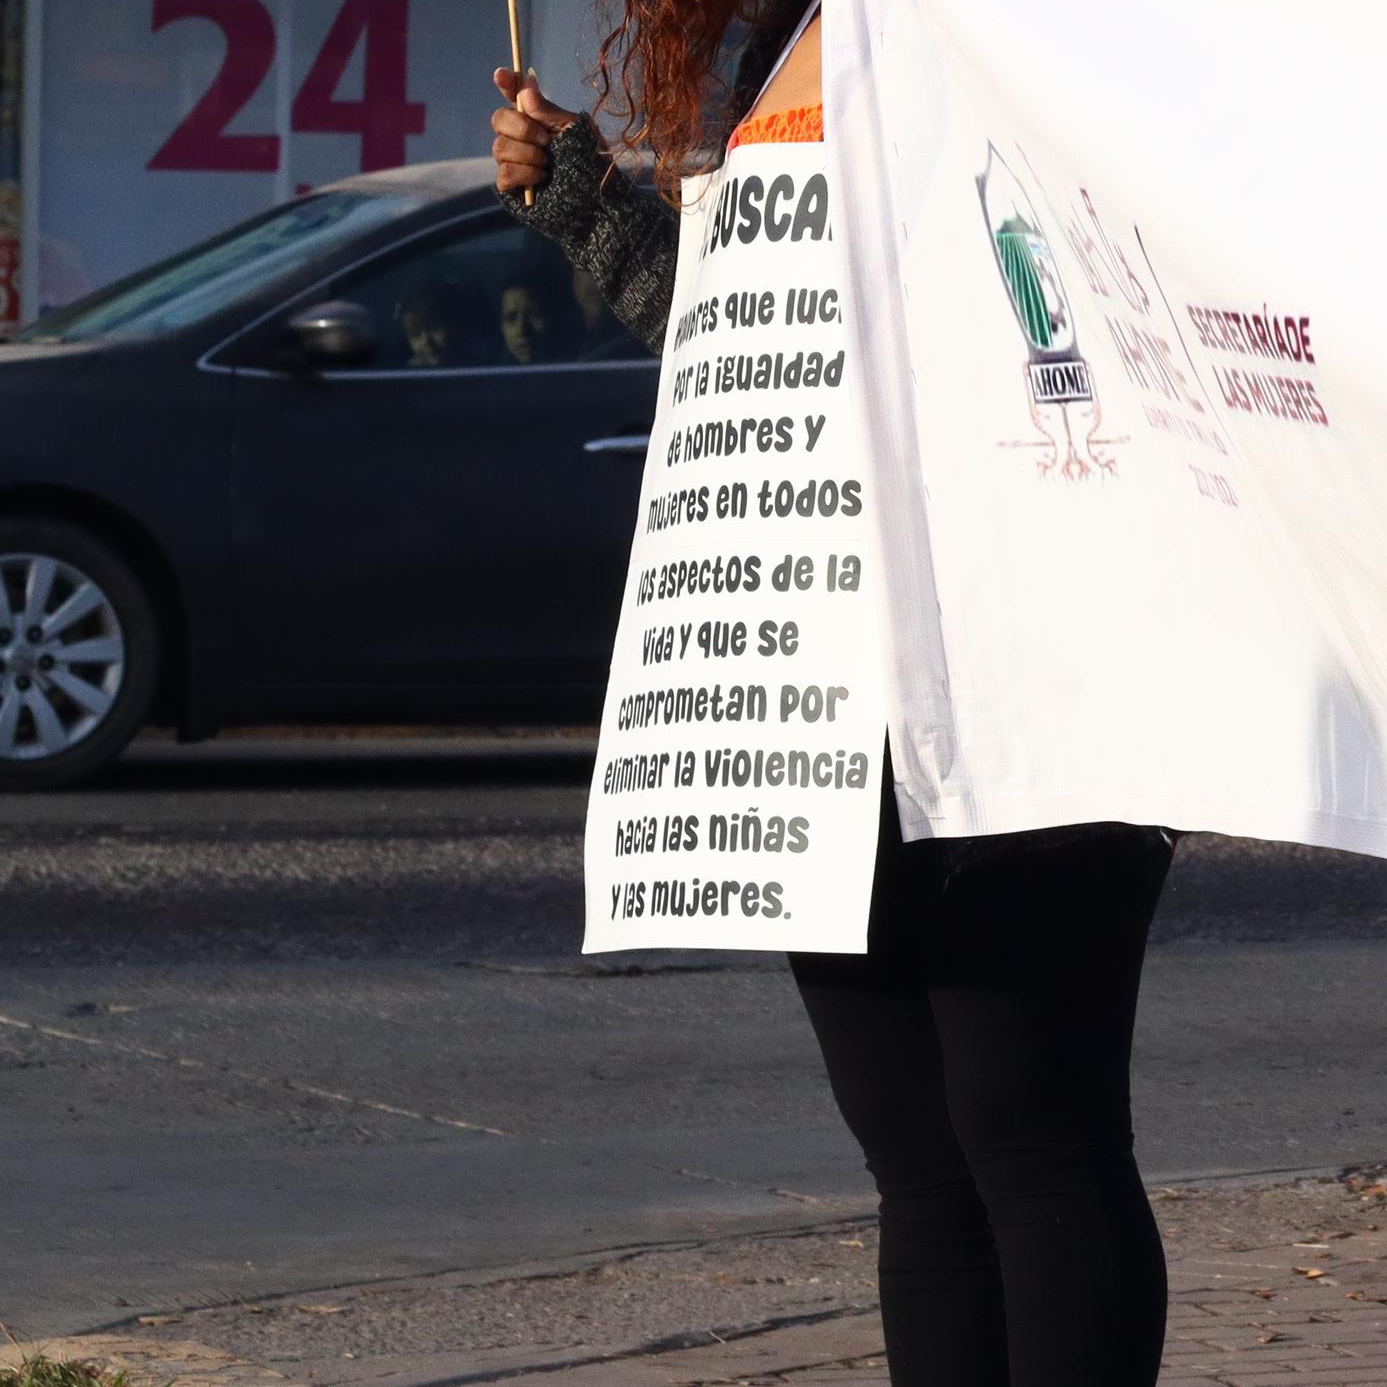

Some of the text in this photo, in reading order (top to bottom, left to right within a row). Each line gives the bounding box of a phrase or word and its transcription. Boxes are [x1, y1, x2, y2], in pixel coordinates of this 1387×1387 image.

[709, 172, 833, 254] BUSCA
[724, 291, 775, 330] que
[786, 288, 842, 326] luc
[1187, 302, 1315, 364] SECRETARÍA DE
[695, 361, 710, 399] la
[714, 350, 845, 395] igualdad
[1033, 365, 1090, 398] AHOME
[1212, 364, 1329, 428] LAS MUJERES
[667, 430, 682, 467] de
[684, 416, 795, 463] hombres
[647, 479, 863, 534] mujeres en todos
[637, 554, 862, 607] los aspectos de la
[697, 620, 748, 659] que
[757, 619, 799, 657] se
[618, 684, 849, 732] comprometan por
[603, 752, 670, 795] eliminar
[675, 750, 696, 788] la
[616, 806, 810, 858] hacia las niñas
[623, 881, 647, 920] las
[650, 877, 792, 920] mujeres.
